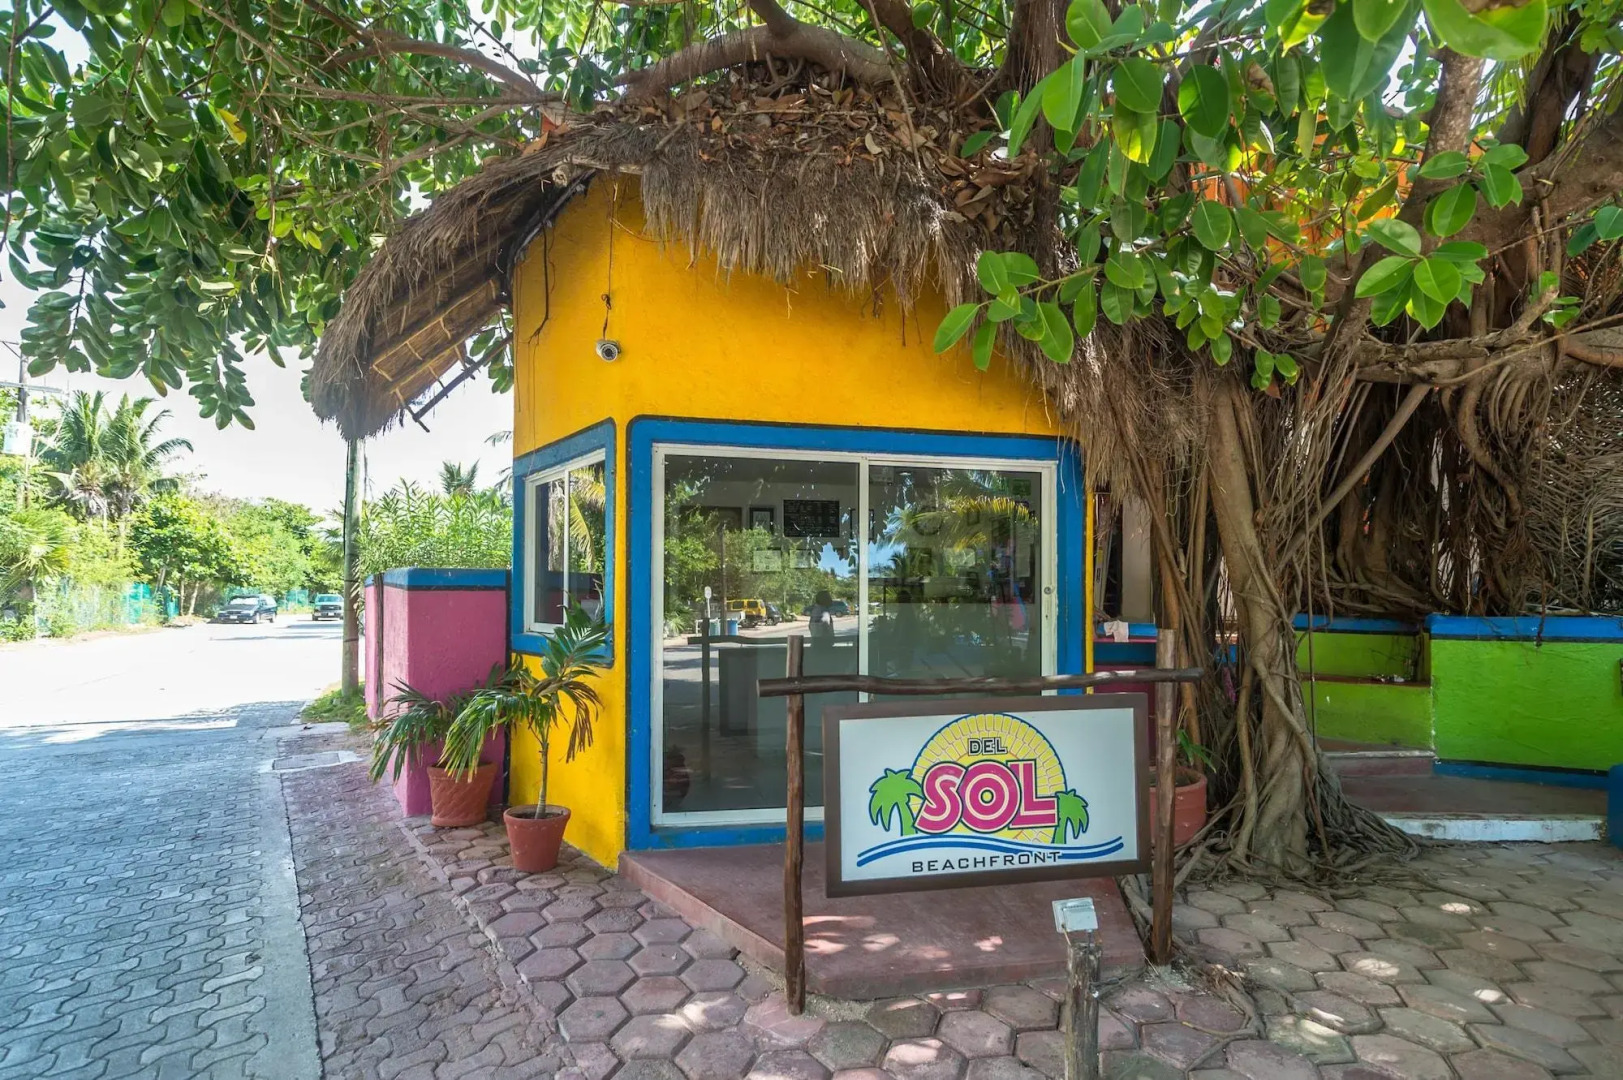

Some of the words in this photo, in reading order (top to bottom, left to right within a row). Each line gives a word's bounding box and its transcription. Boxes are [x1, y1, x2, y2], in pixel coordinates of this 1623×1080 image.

[967, 738, 1007, 755] DEL
[914, 759, 1059, 833] SOL
[912, 852, 1061, 872] BEACHFRONT
